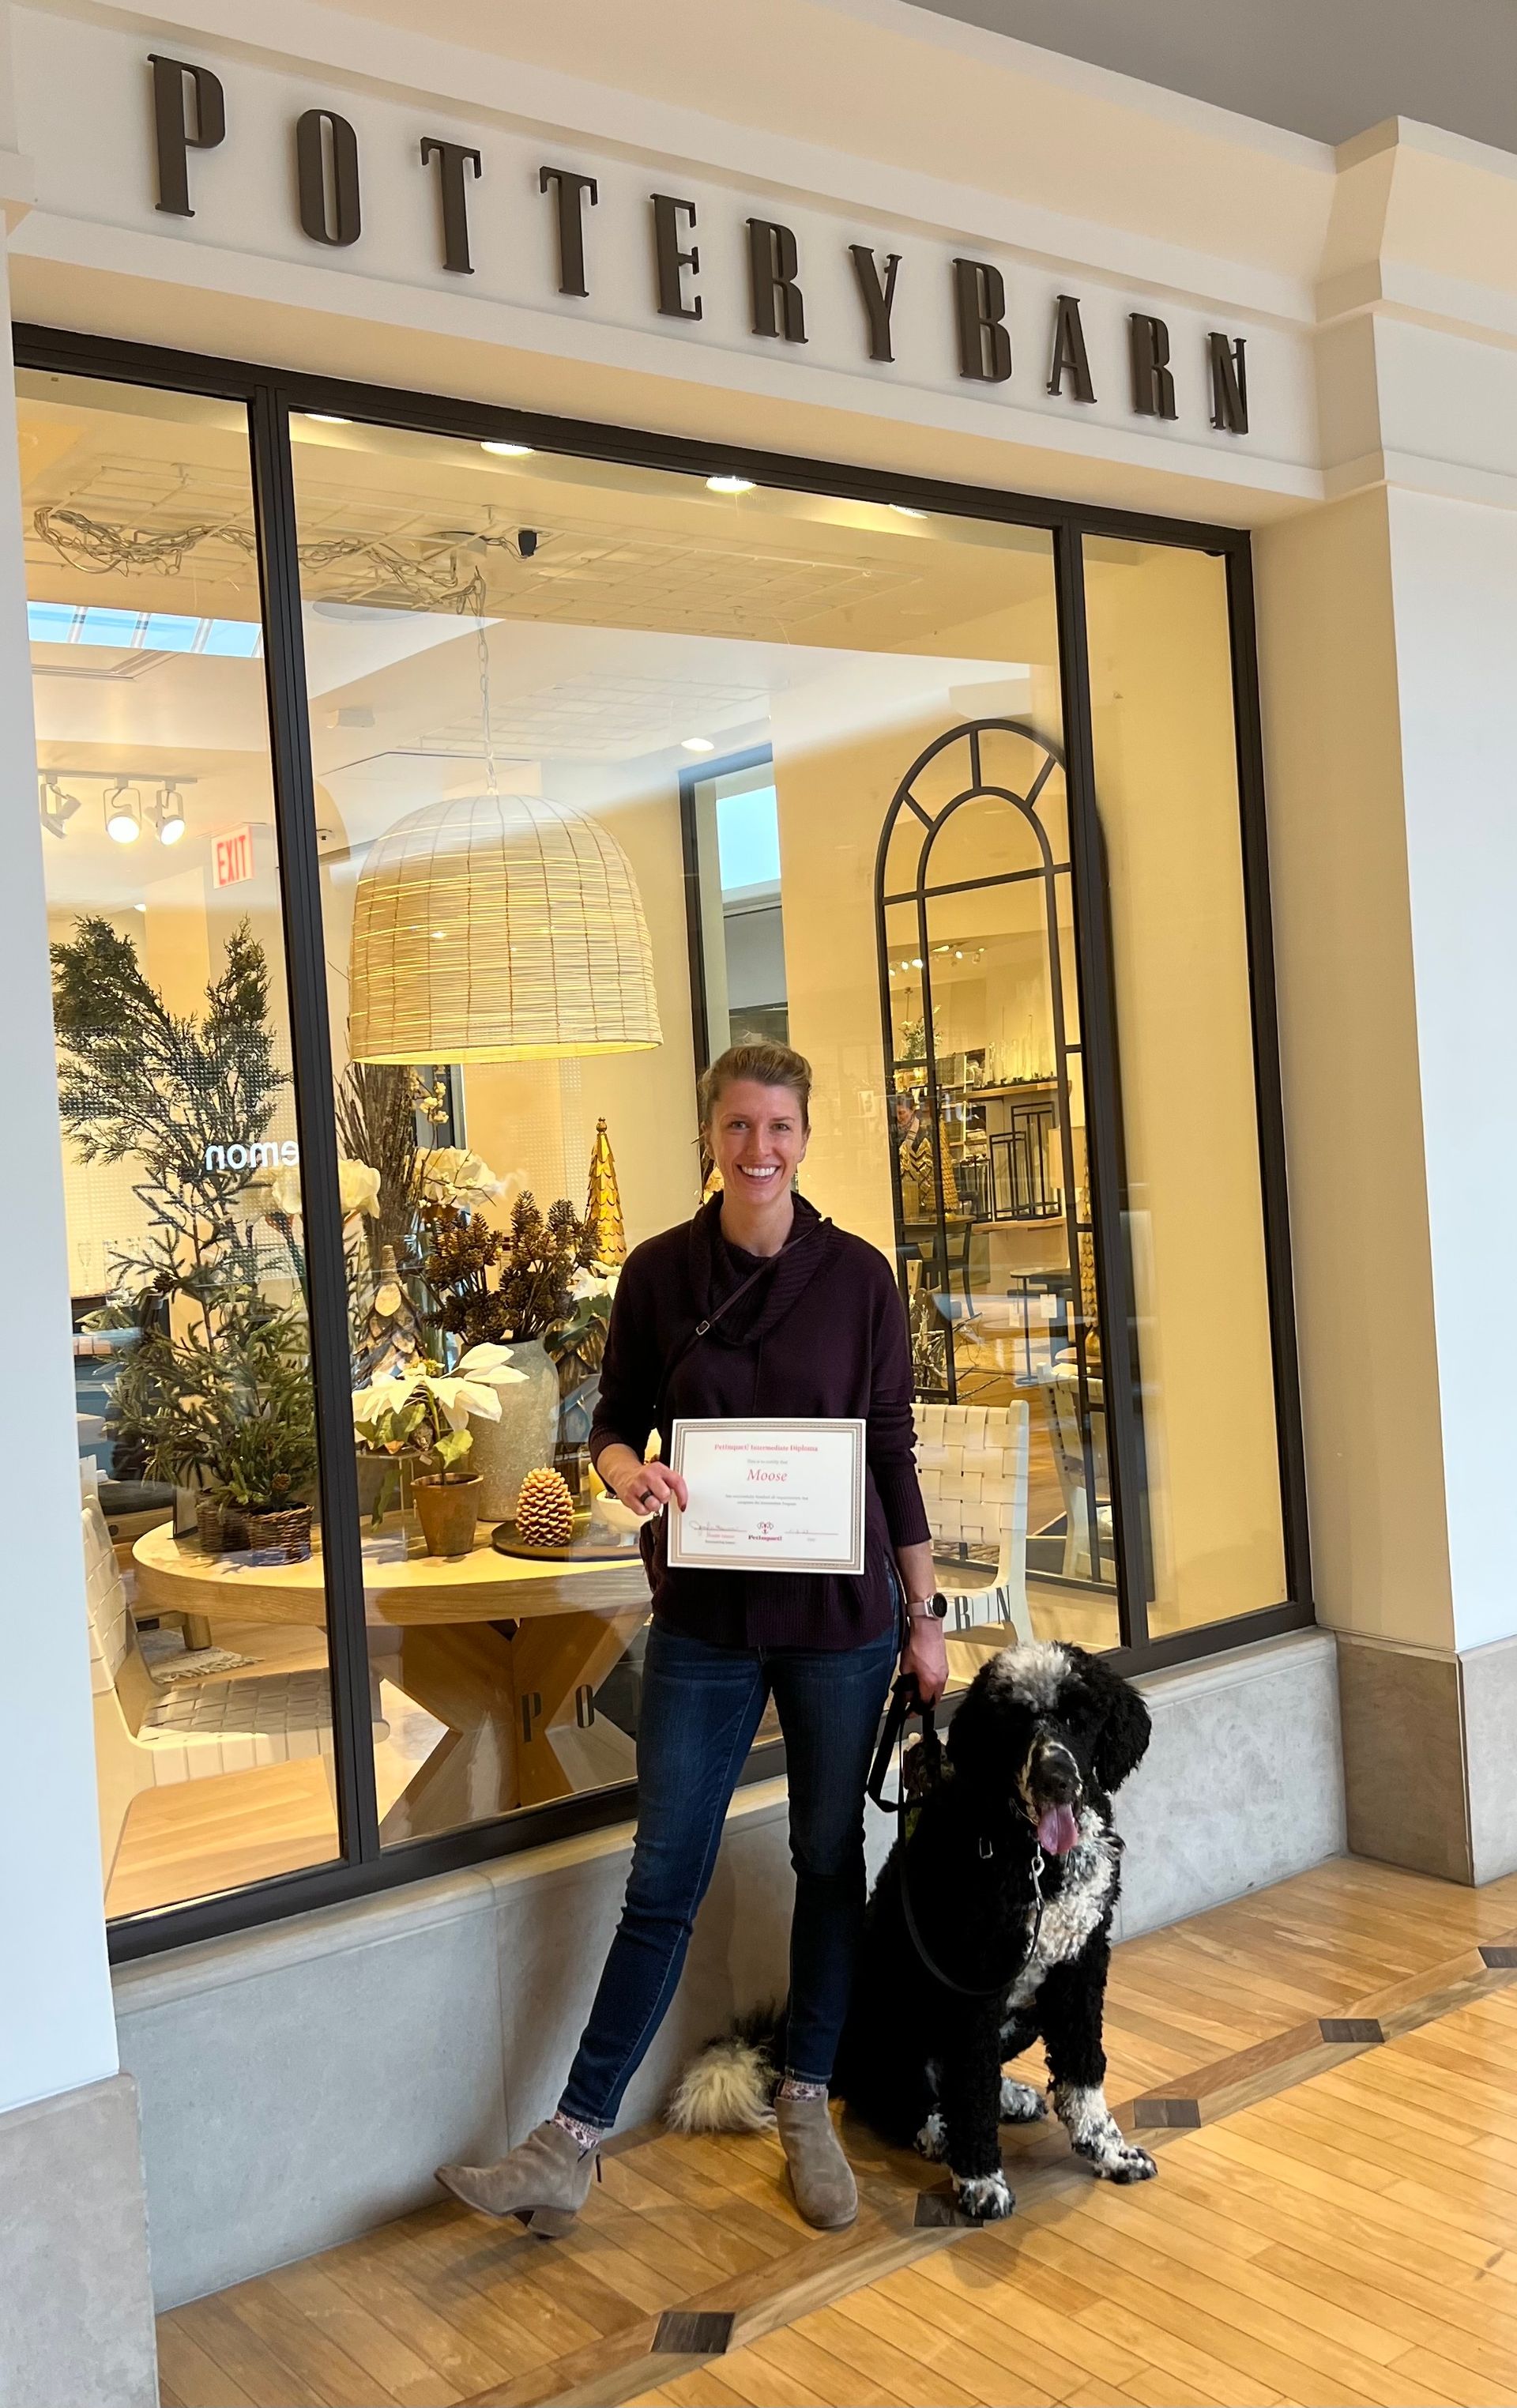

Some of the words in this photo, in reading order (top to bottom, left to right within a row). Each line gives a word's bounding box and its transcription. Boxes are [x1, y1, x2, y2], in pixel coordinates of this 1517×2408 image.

[147, 54, 902, 362] POTTERY
[952, 257, 1248, 435] BARN
[217, 835, 246, 885] EXIT
[747, 1468, 788, 1482] Moose
